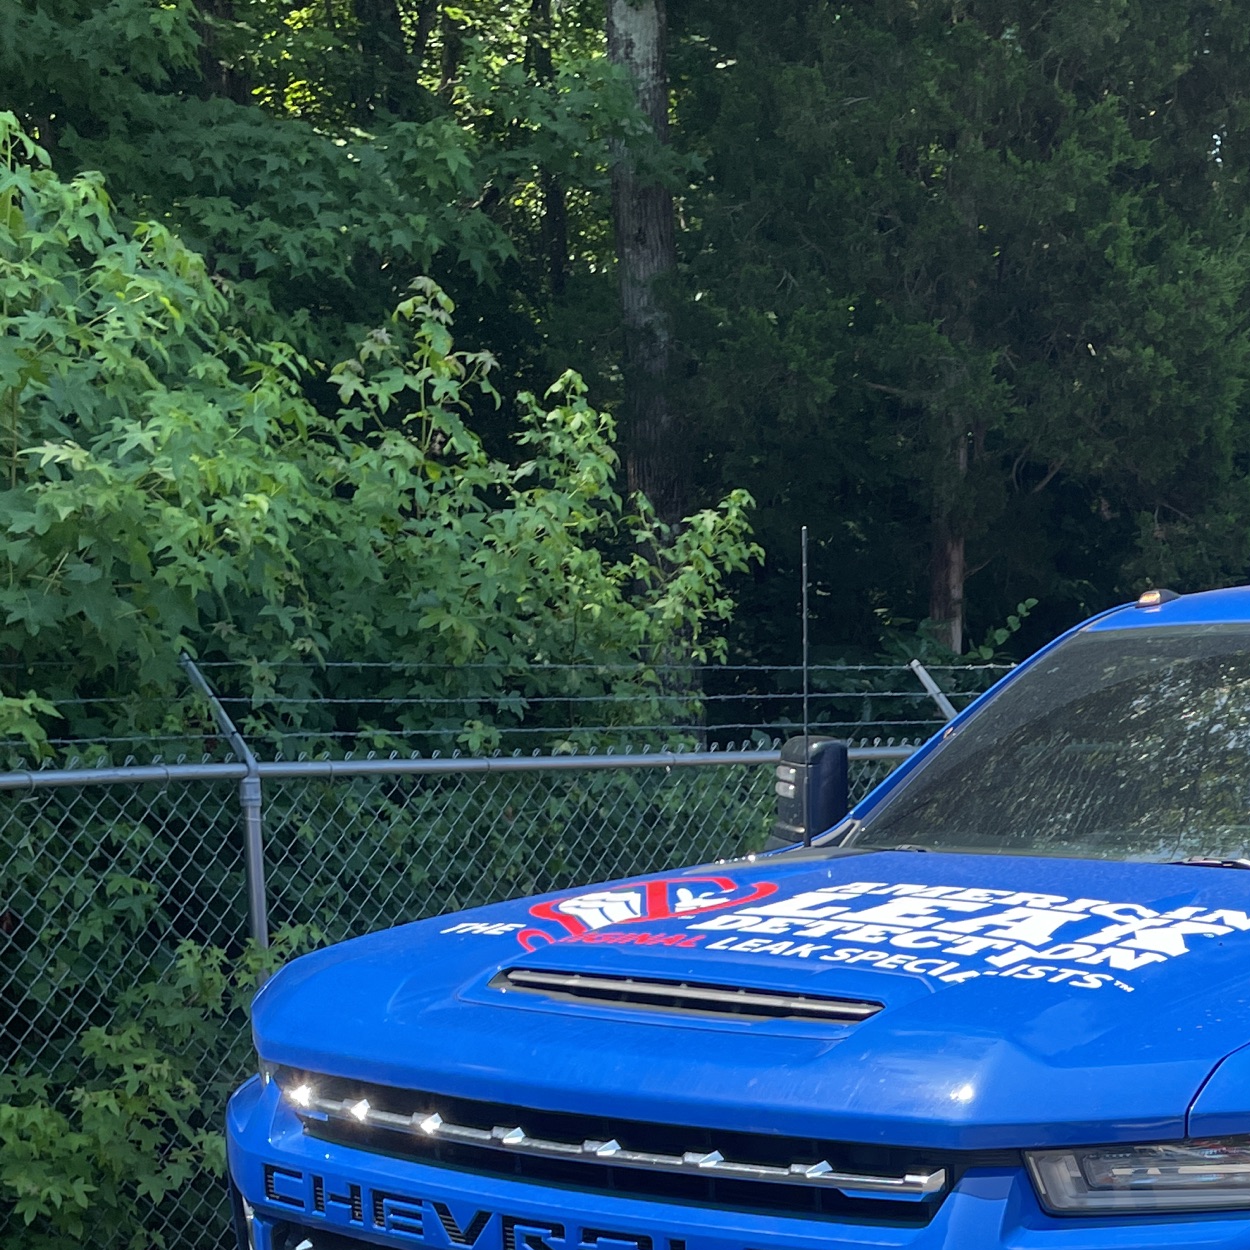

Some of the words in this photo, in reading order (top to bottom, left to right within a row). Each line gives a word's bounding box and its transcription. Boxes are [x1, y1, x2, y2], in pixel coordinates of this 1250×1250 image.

[440, 921, 527, 936] THE
[704, 936, 832, 958] LEAK
[733, 891, 1235, 957] LEAK
